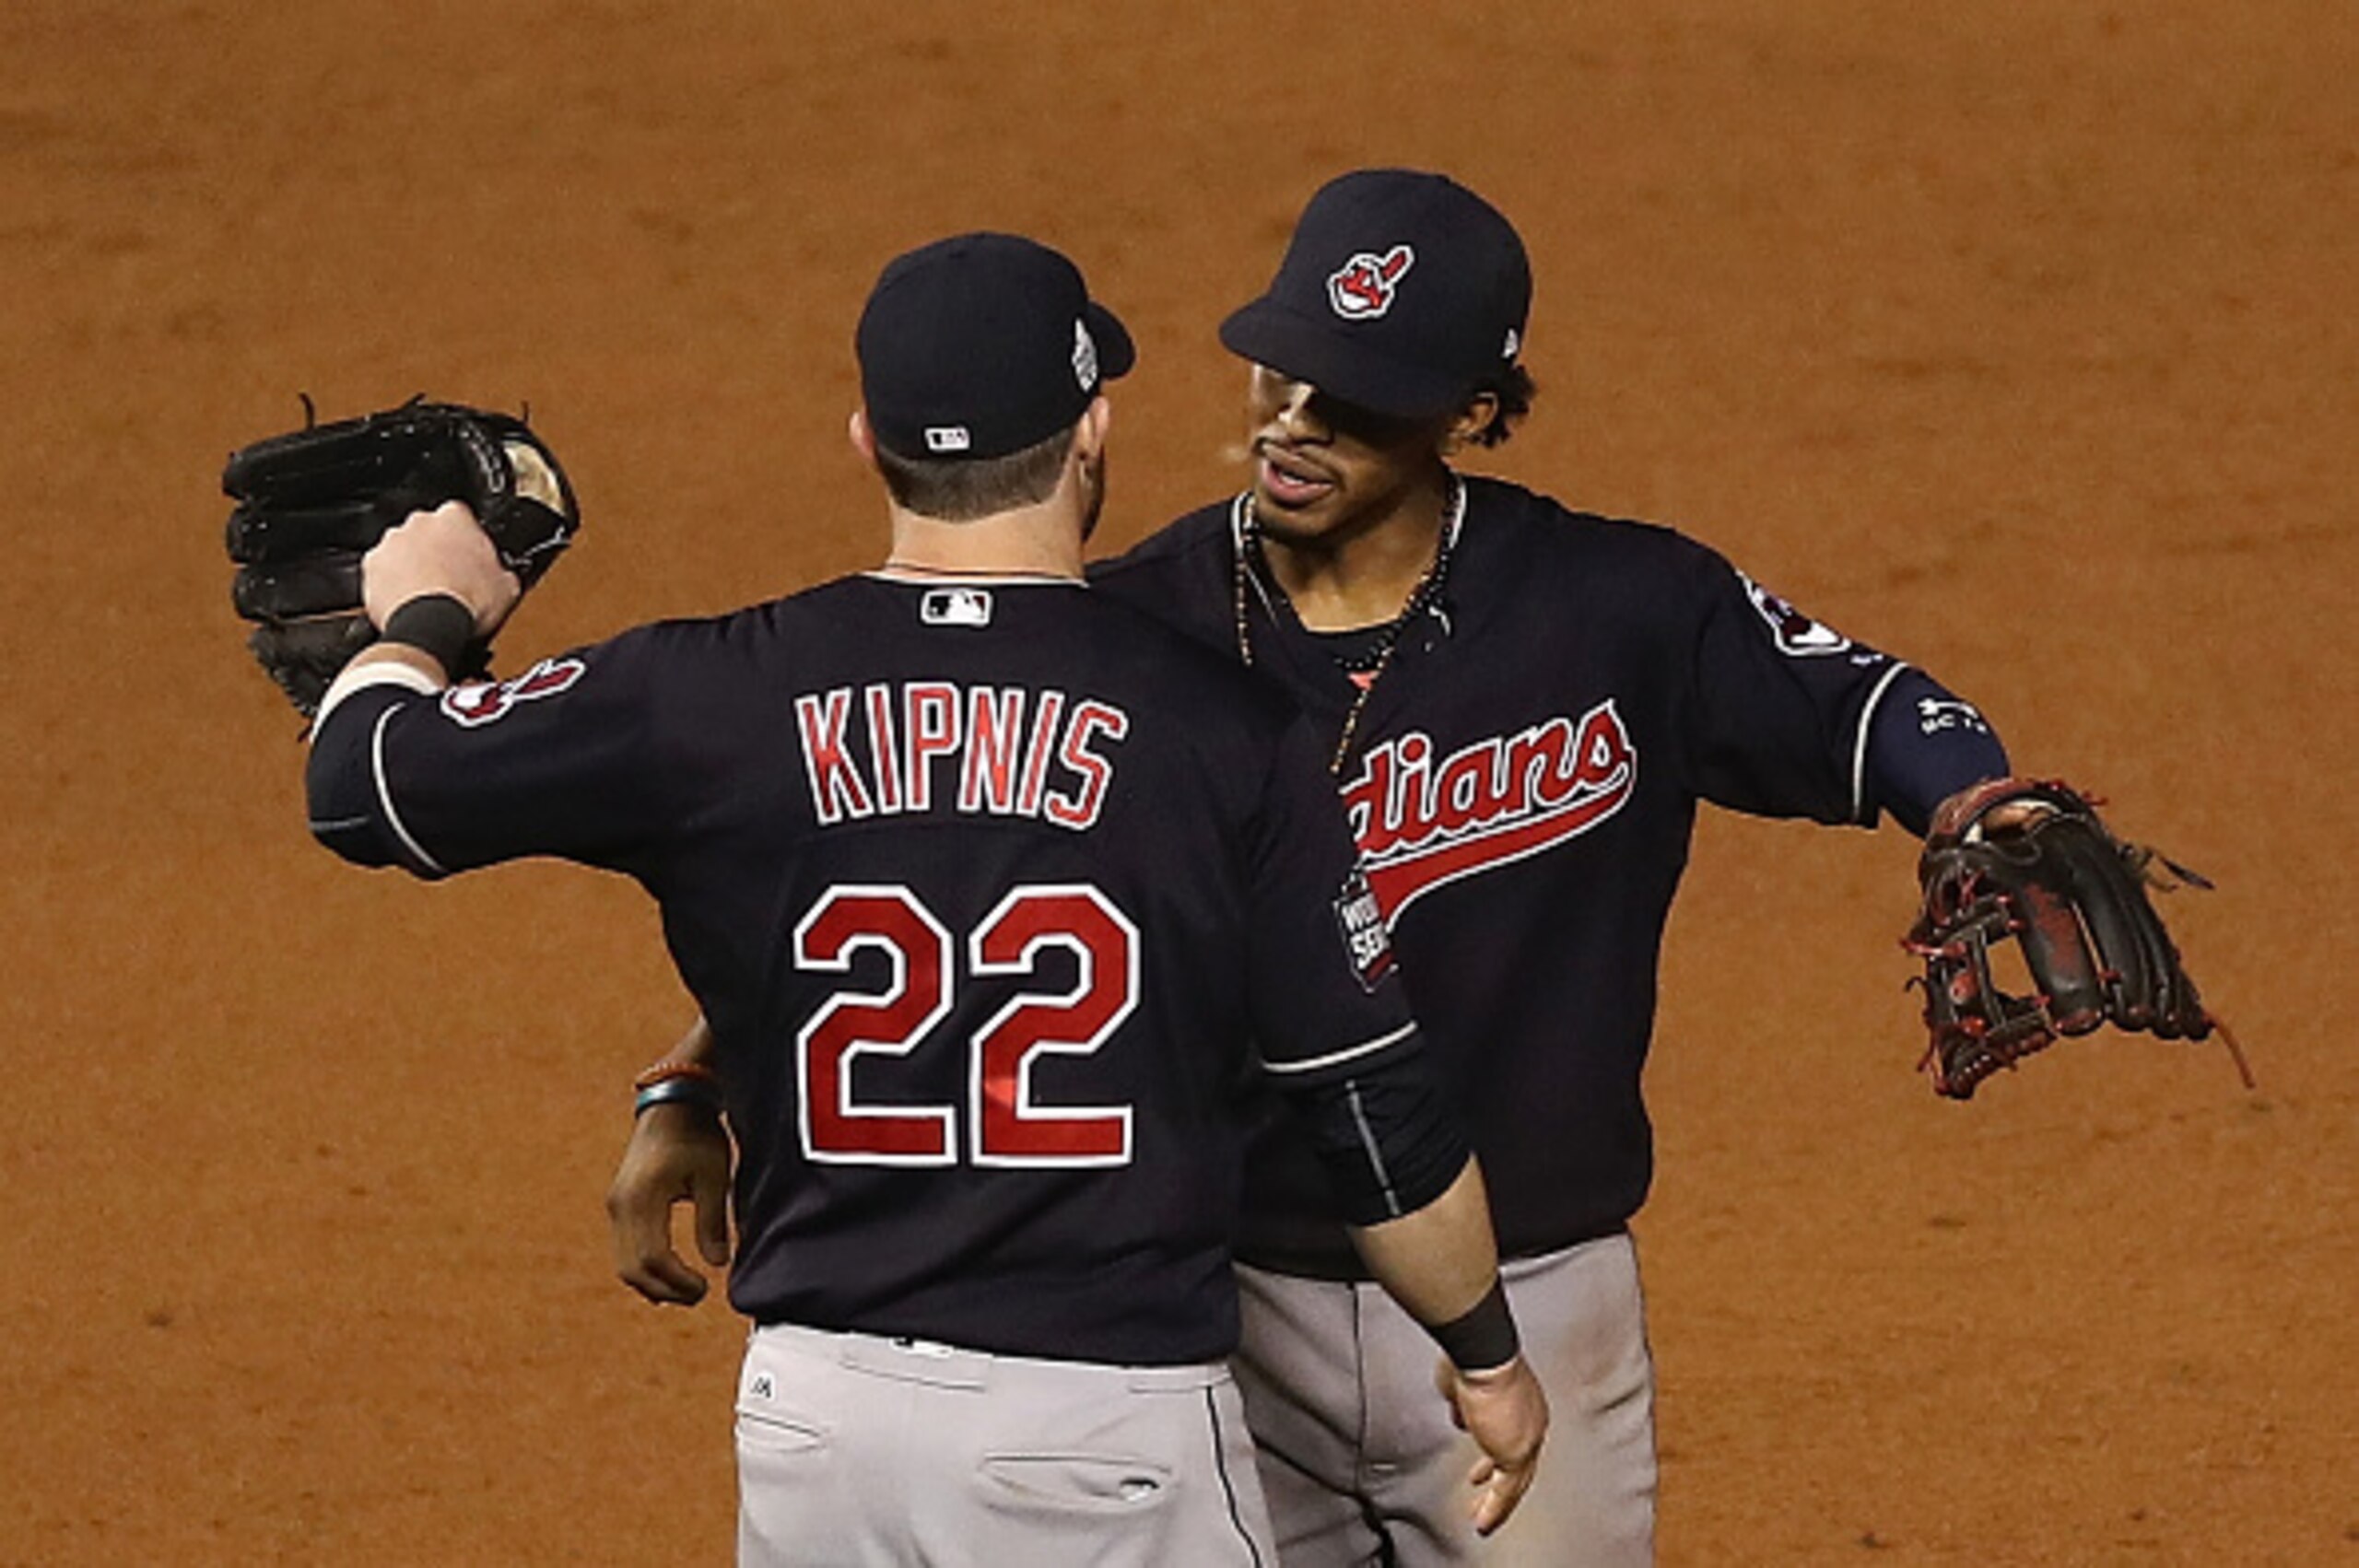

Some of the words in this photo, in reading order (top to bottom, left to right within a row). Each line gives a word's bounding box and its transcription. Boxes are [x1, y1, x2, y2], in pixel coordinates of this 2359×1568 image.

[794, 682, 1129, 830] KIPNIS
[1338, 697, 1637, 860] dians
[793, 883, 1141, 1167] 22
